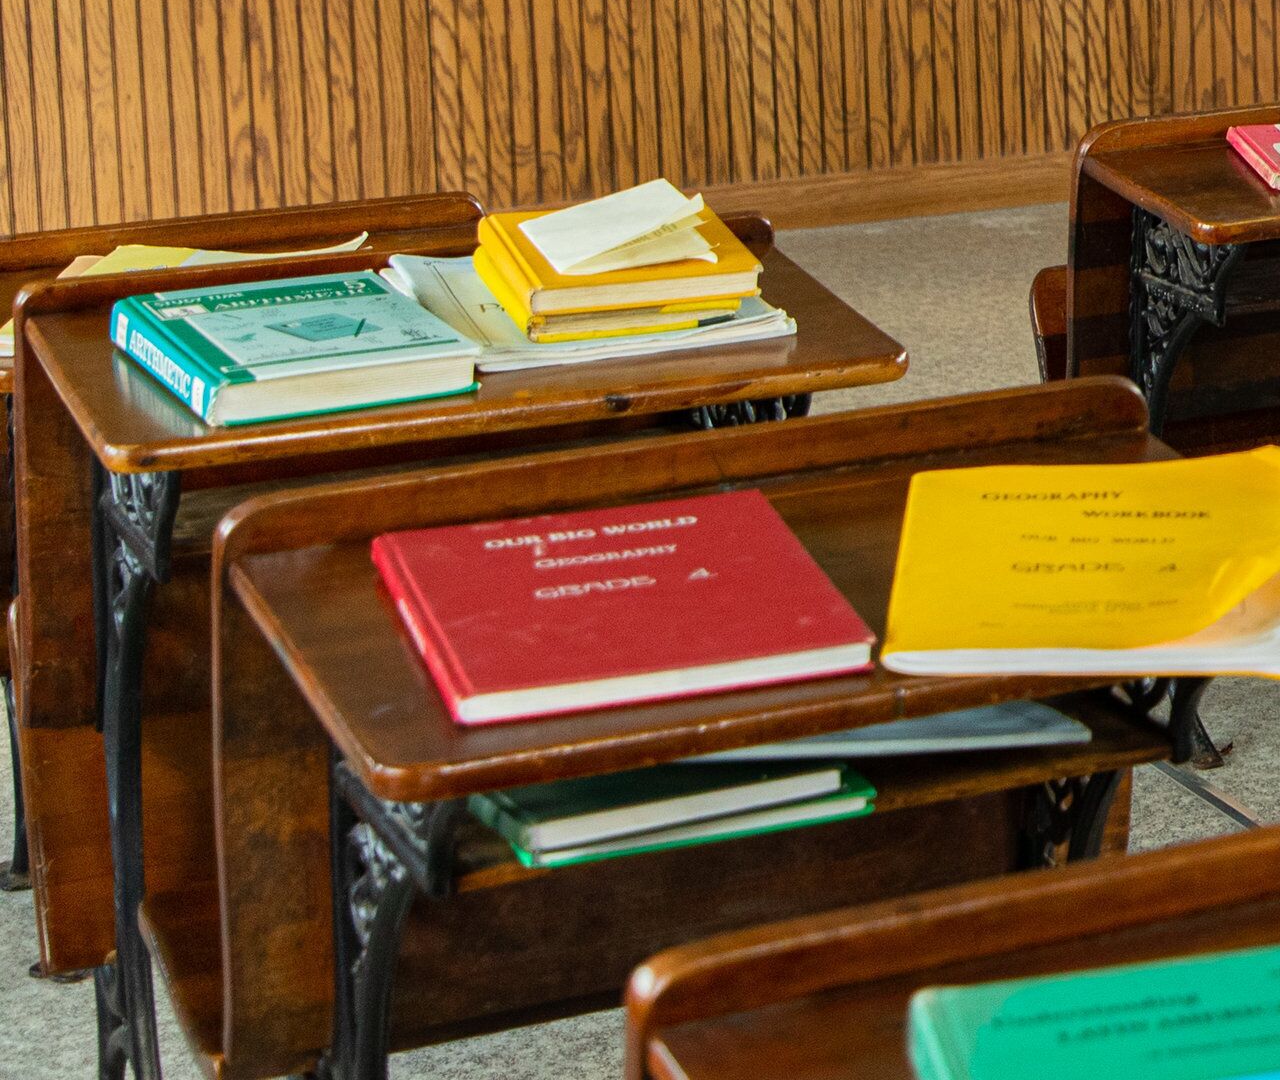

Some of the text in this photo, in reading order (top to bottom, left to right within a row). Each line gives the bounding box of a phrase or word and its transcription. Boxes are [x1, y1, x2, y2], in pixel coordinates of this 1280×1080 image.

[129, 328, 192, 399] ARITHMETIC
[981, 490, 1123, 502] GEOGRAPHY
[484, 515, 698, 550] OUR BIG WORLD
